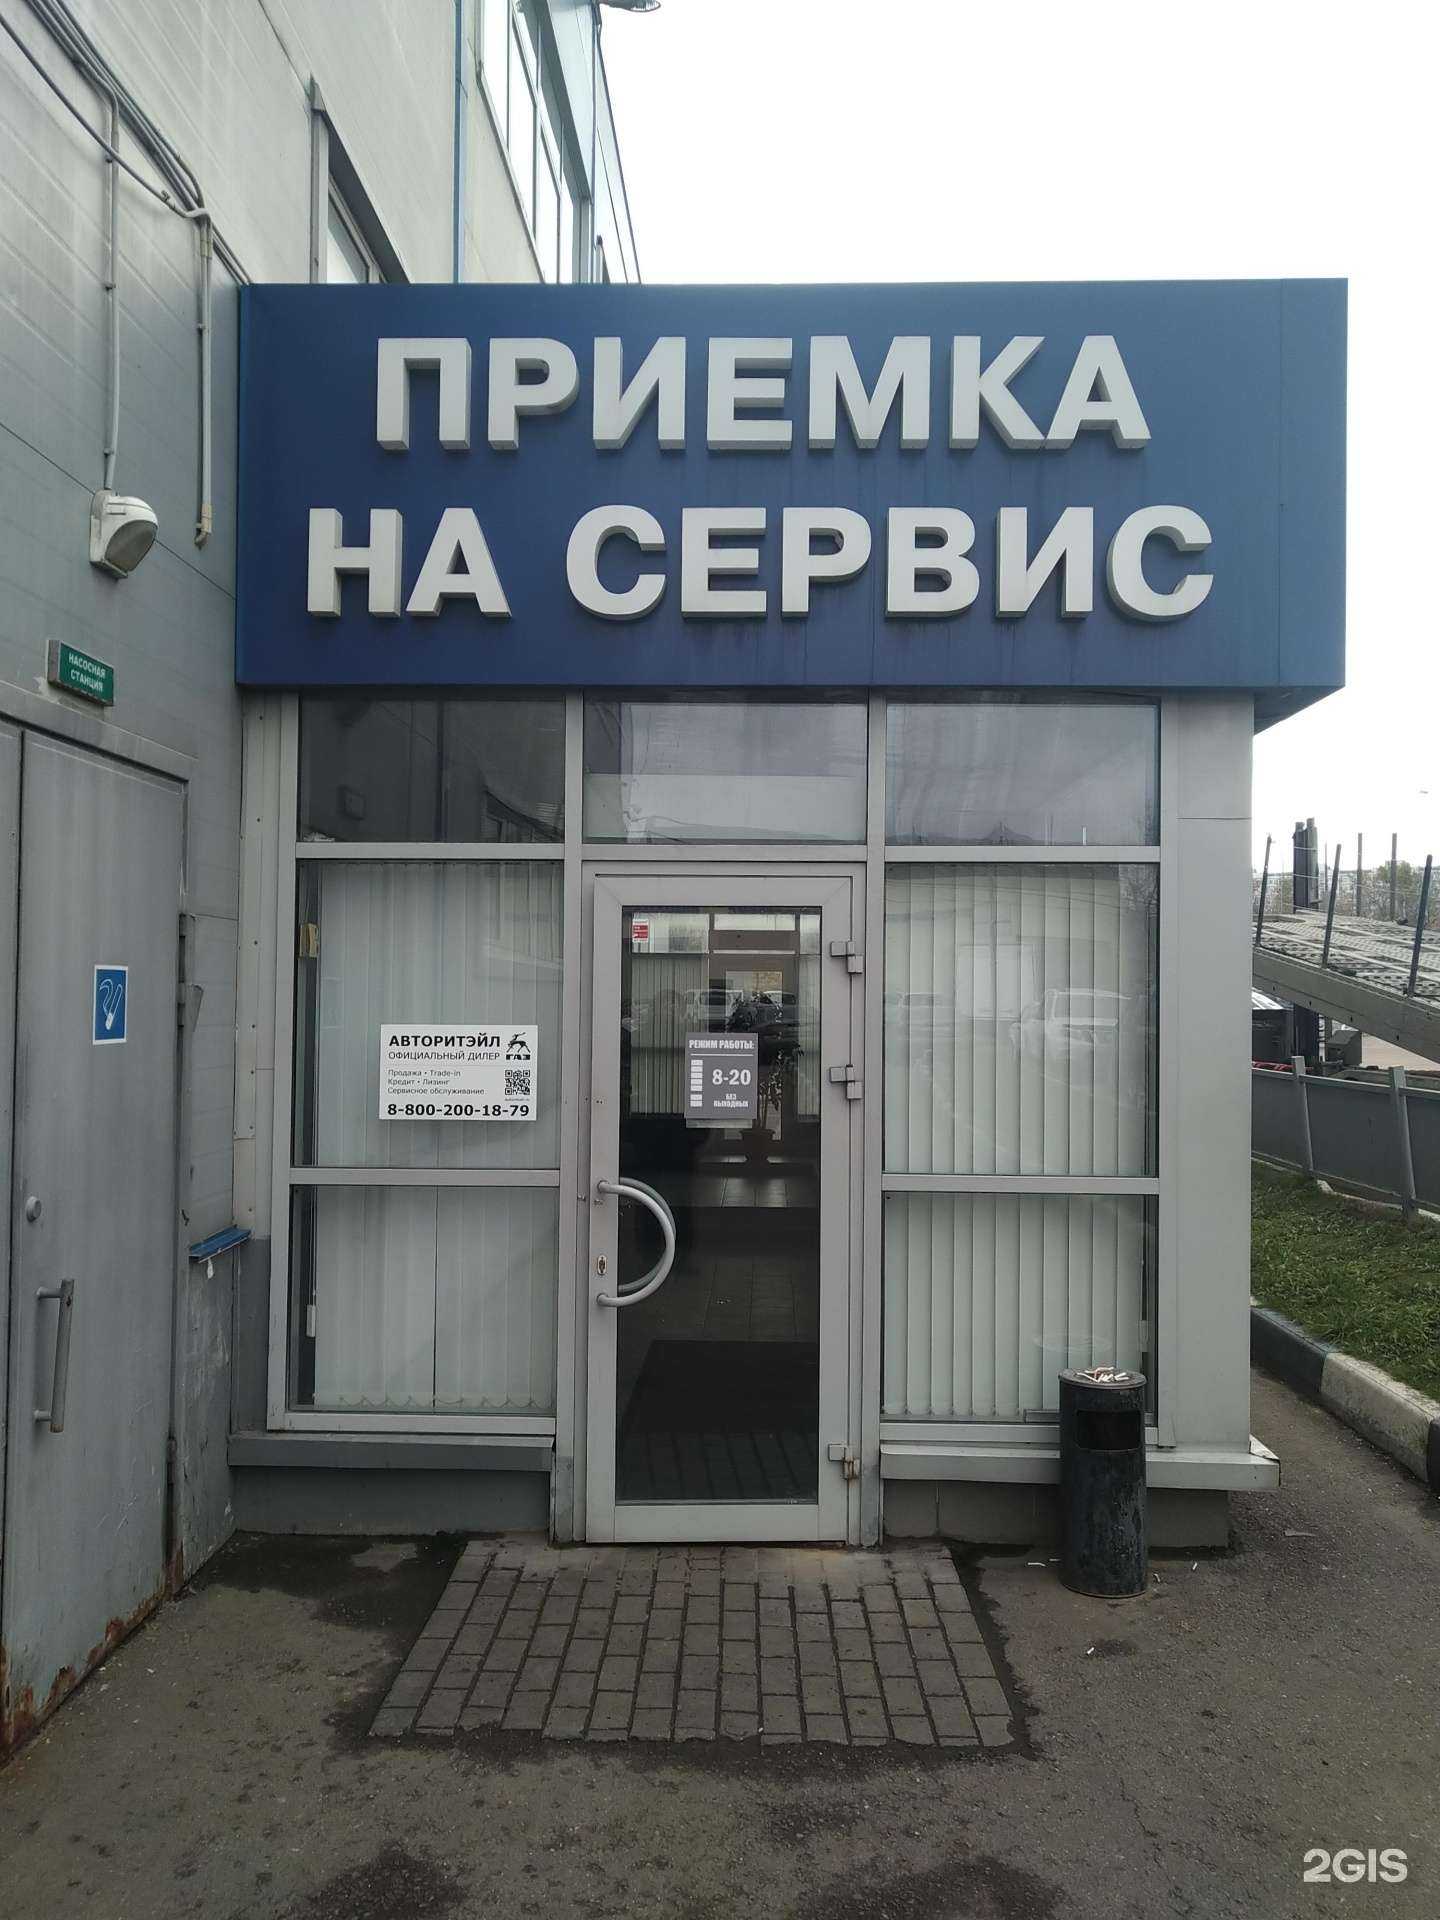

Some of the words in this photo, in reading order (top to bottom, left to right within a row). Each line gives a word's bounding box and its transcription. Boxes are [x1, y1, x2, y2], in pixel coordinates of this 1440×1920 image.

[375, 334, 1151, 451] ПРИЕМКА
[307, 506, 513, 619] НА
[565, 504, 1214, 623] СЕРВИС
[69, 652, 106, 679] НАСОСНАЯ
[70, 669, 103, 692] СТАНЦИЯ
[389, 1032, 500, 1047] АВТОРИТЭЙЛ
[689, 1039, 718, 1049] РЕЖИМ
[388, 1051, 465, 1061] ОФИЦИАЛЬНЫЙ
[467, 1052, 500, 1061] ДИЛЕР
[387, 1069, 422, 1077] Продажа
[430, 1069, 461, 1077] Trade-in
[712, 1068, 751, 1085] 8-20
[387, 1087, 428, 1095] Сервисное
[430, 1087, 485, 1096] обслуживание
[387, 1103, 530, 1117] 8-800-200-18-79
